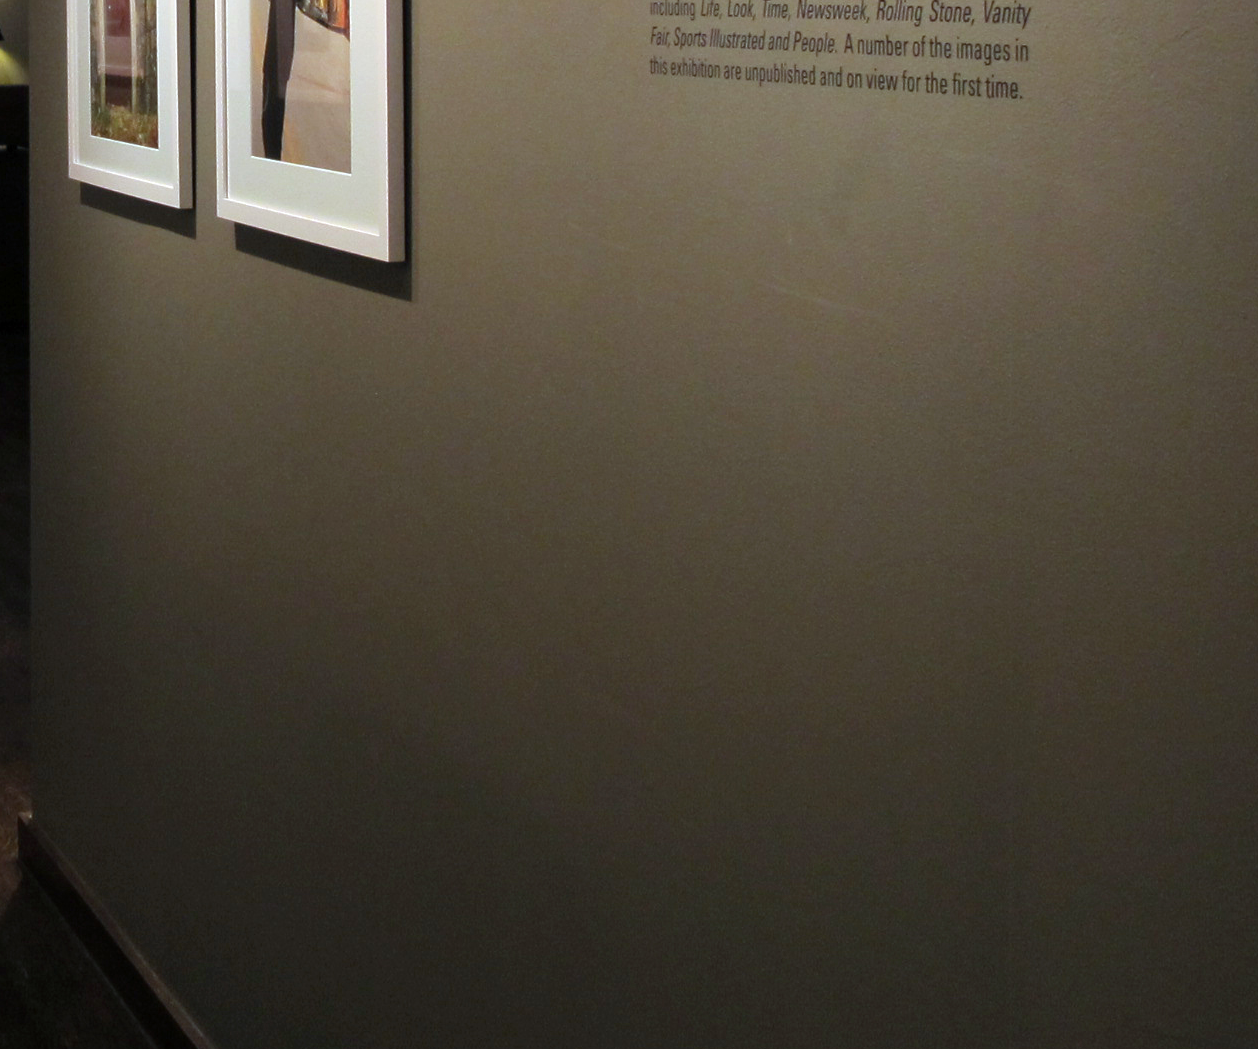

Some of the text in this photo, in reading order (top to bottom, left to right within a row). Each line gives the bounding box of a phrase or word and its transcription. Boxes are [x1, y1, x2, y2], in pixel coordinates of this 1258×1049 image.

[876, 0, 924, 27] Rolling
[929, 0, 976, 26] Stone,
[983, 0, 1032, 30] Vanity
[650, 25, 1029, 66] Fair, Sports Illustrated and People. A number of the images in
[649, 55, 1024, 100] this exhibition are unpublished and on view for the first time.
